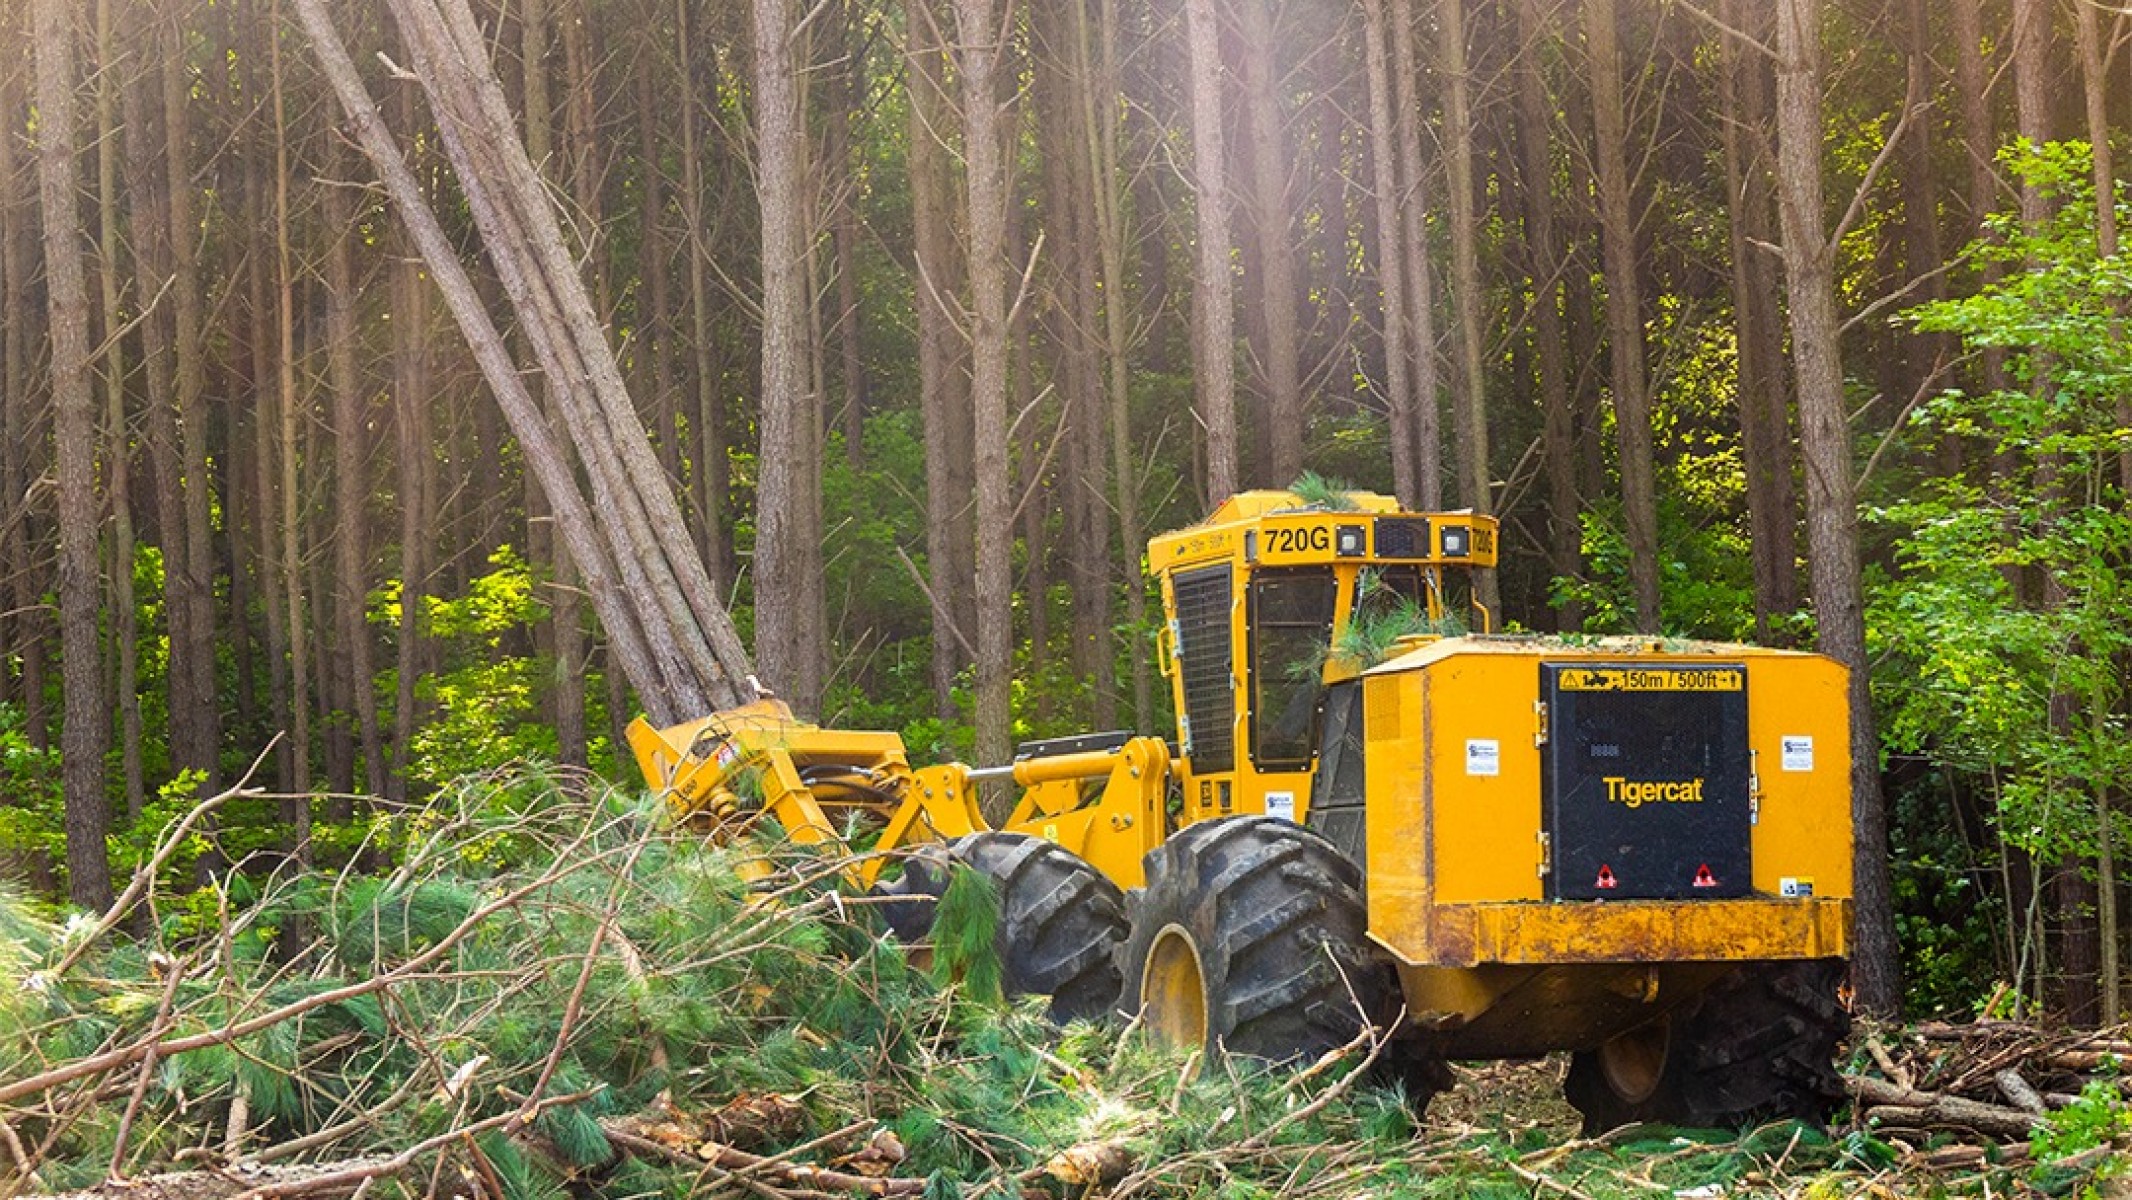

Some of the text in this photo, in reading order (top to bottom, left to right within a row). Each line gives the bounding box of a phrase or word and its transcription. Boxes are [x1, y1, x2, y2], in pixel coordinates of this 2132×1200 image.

[1264, 526, 1330, 553] 720G
[1622, 671, 1663, 688] 150m
[1677, 671, 1718, 688] 500ft
[1602, 777, 1705, 808] Tigercat
